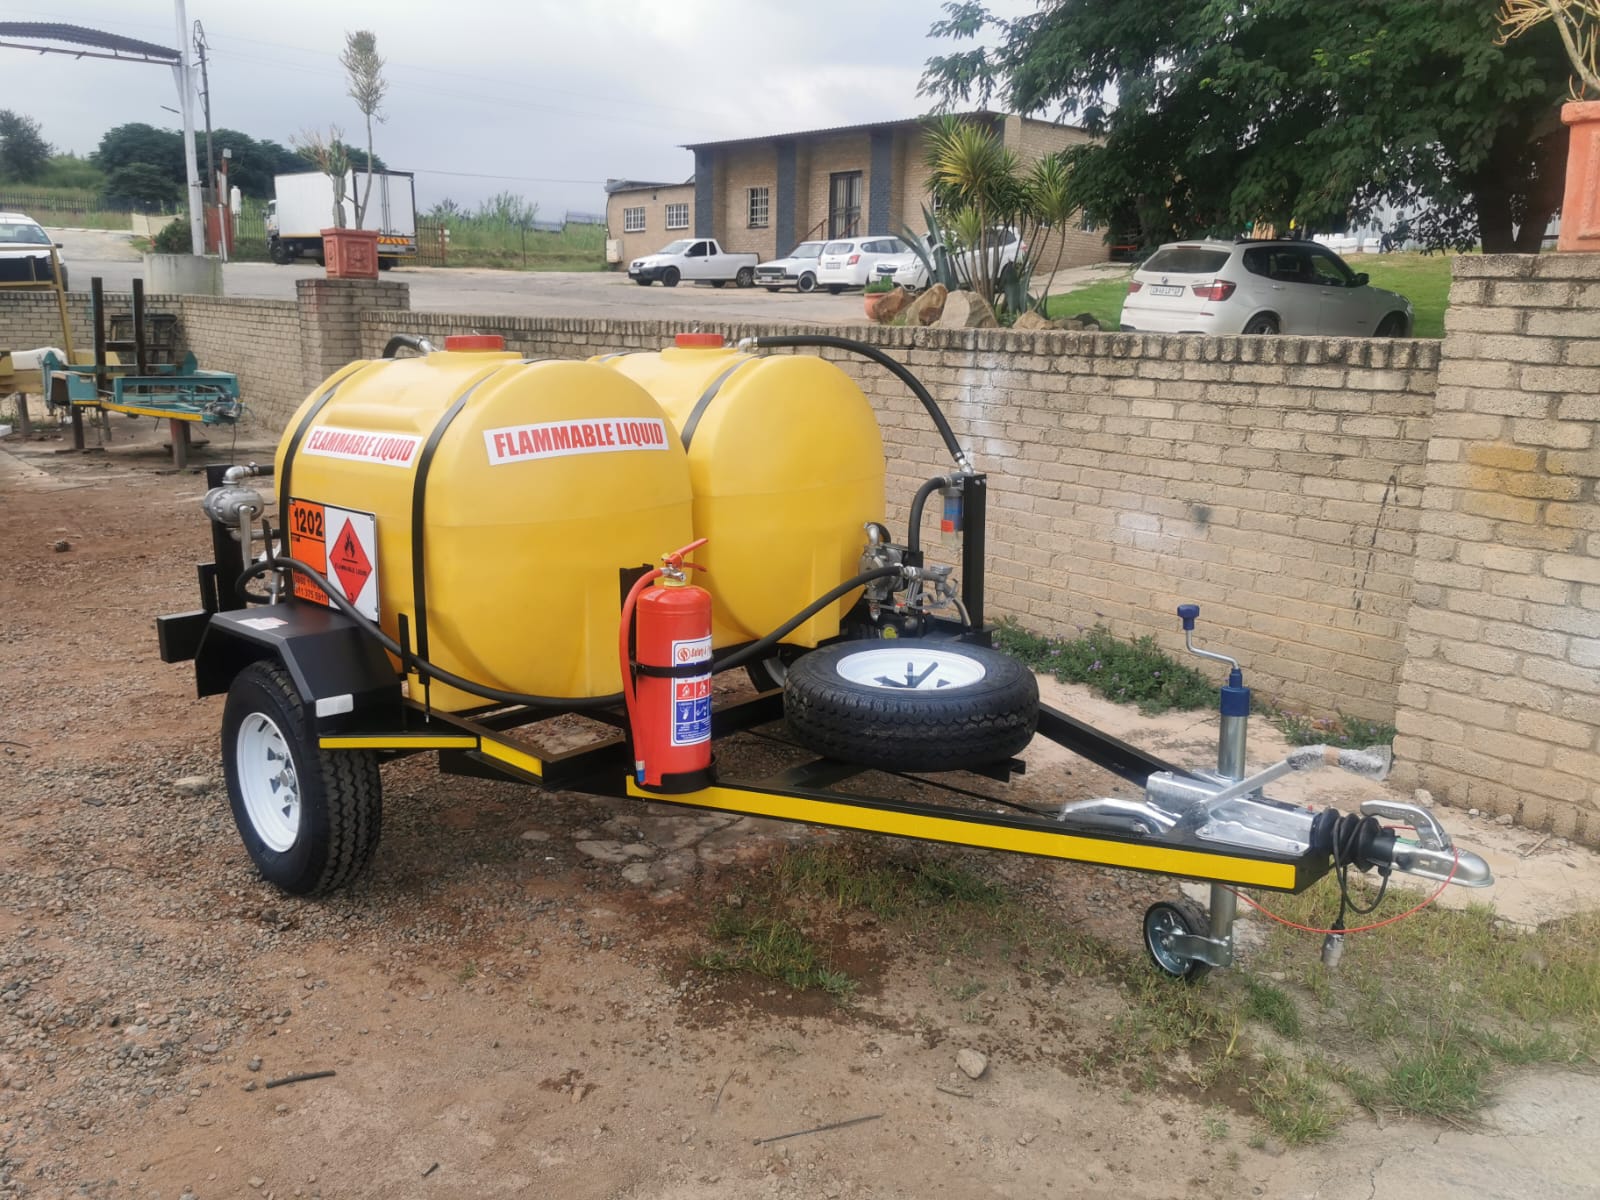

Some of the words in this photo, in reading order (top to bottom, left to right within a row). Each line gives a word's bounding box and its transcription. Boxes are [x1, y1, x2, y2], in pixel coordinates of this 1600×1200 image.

[308, 430, 373, 457] FLAMMABLE
[372, 437, 416, 461] LIQUID
[493, 423, 615, 457] FLAMMABLE
[616, 423, 664, 447] LIQUID
[294, 507, 323, 537] 1202
